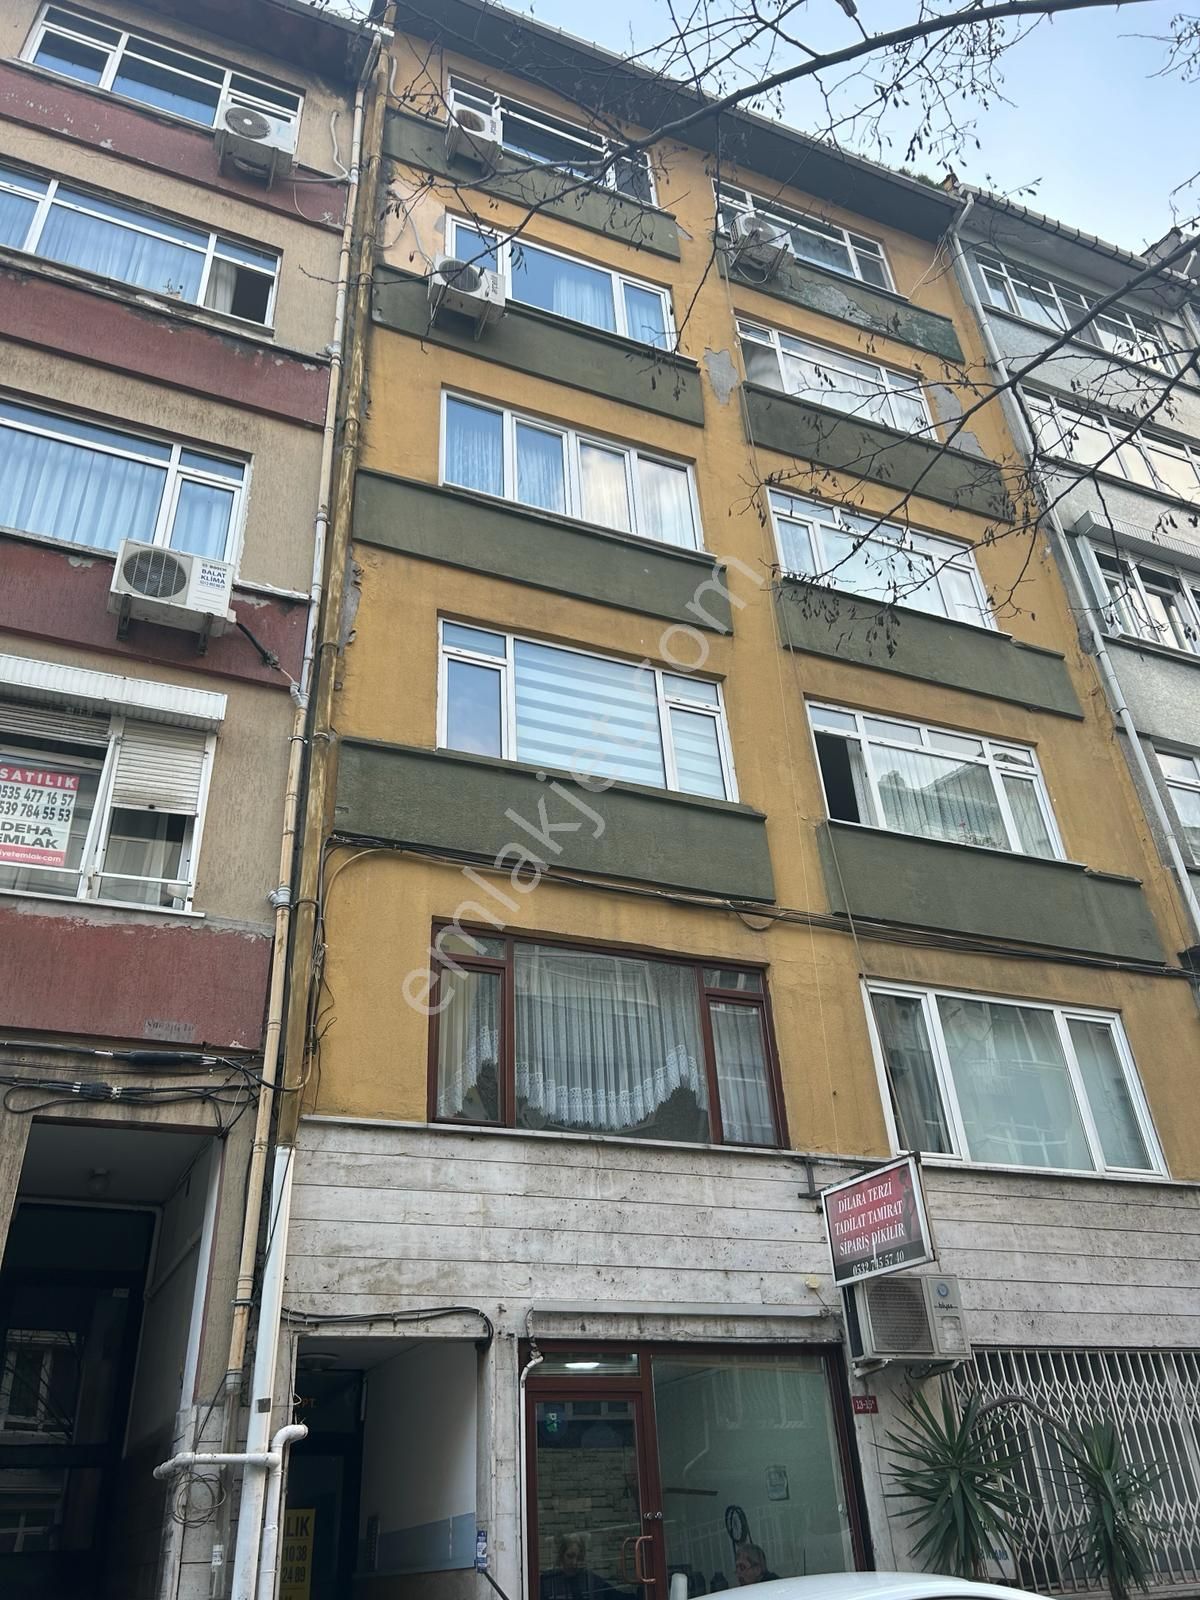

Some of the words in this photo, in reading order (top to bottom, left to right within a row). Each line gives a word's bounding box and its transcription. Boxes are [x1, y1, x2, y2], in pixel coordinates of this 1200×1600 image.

[201, 568, 226, 578] BALAT
[0, 768, 76, 789] SATILIK
[24, 788, 44, 803] 477
[47, 791, 58, 805] 16
[61, 793, 75, 807] 57
[20, 802, 40, 819] 784
[42, 806, 56, 821] 55
[57, 808, 71, 823] 53
[1, 821, 53, 837] DEHA
[838, 1193, 866, 1214] DİLARA
[867, 1177, 892, 1202] TERZİ
[835, 1213, 866, 1236] TADİLAT
[868, 1200, 903, 1225] TAMİRAT
[840, 1232, 870, 1256] SİPARİŞ
[871, 1220, 905, 1246] DİKİLİR
[852, 1262, 869, 1276] 0532
[885, 1254, 894, 1267] 57
